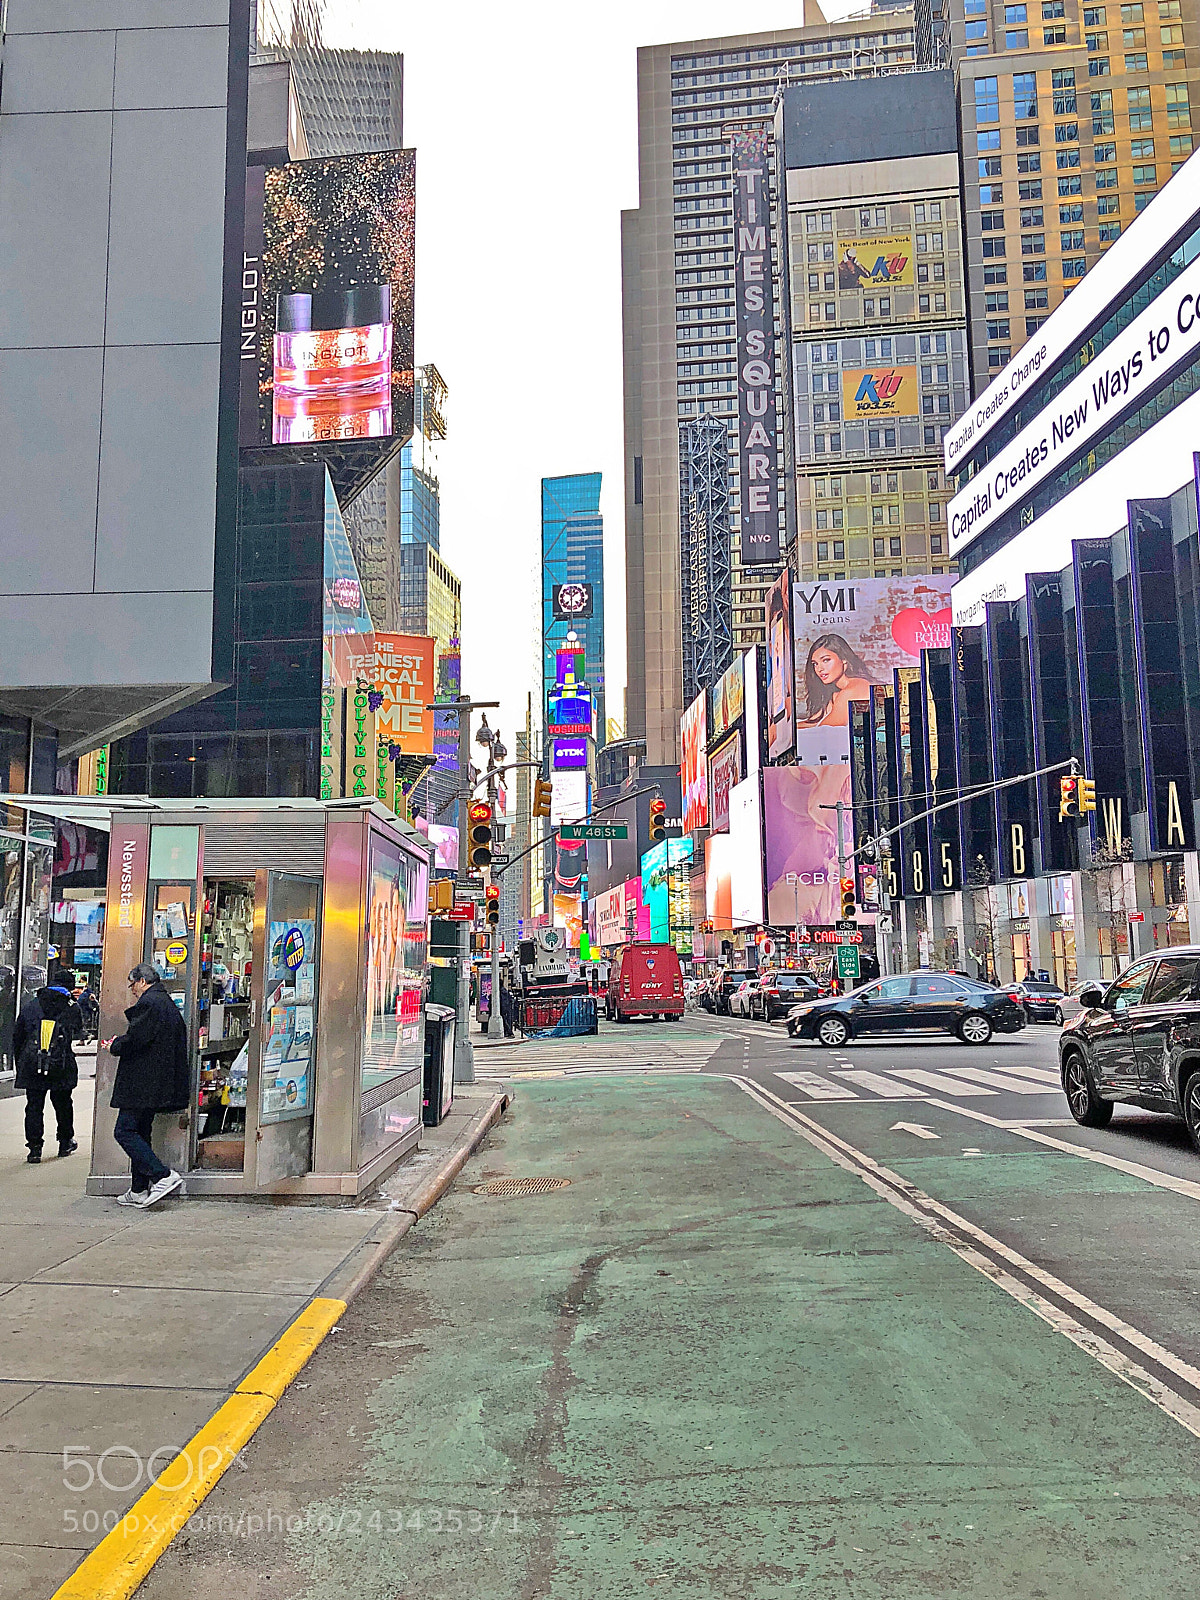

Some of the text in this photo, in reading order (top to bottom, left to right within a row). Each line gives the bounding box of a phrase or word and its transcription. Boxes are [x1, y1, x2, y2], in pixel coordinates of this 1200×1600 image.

[241, 252, 258, 359] INGLOT
[303, 345, 366, 360] INGLOT
[737, 169, 772, 513] TIMES SQUARE
[948, 345, 1047, 459] Capital Creates Change
[952, 483, 991, 539] Capital
[994, 438, 1048, 500] Creates
[1052, 399, 1088, 449] New
[1092, 350, 1143, 412] Ways
[1148, 326, 1170, 361] to
[750, 535, 772, 543] NYC
[689, 494, 699, 638] AMERICAN EAGLE
[795, 584, 857, 614] YMI
[956, 581, 1007, 625] Morgan Stanley
[812, 614, 851, 625] Jeans
[383, 684, 424, 705] ALL
[354, 694, 368, 757] OLIVE
[548, 724, 592, 734] TOSHIBA
[563, 748, 585, 757] TDK
[377, 747, 389, 799] OLIVE
[572, 828, 582, 837] W
[604, 828, 616, 837] St
[119, 840, 136, 928] Newsstand
[785, 872, 840, 885] BCBG
